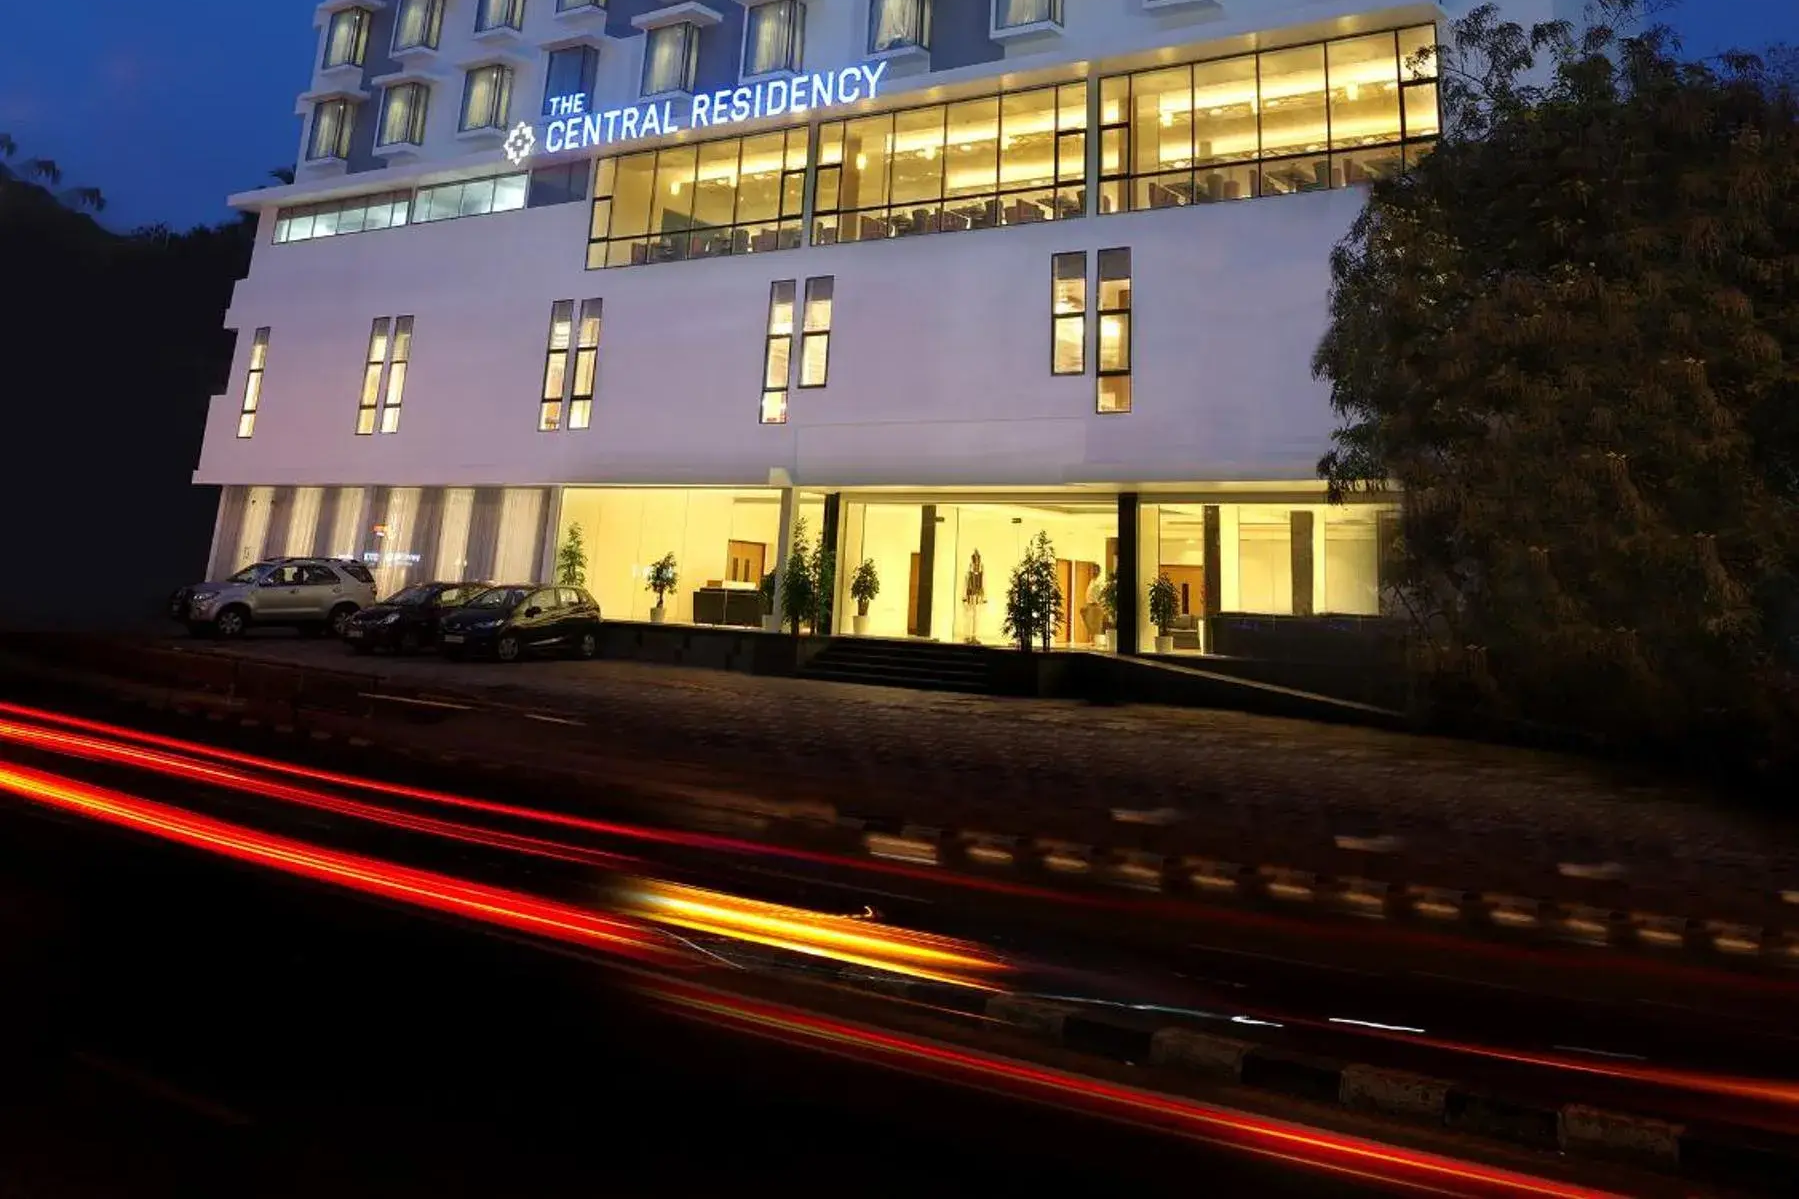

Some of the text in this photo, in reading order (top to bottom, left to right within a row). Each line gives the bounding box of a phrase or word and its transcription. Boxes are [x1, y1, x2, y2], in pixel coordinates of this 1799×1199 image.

[545, 61, 888, 153] CENTRAL RESIDENCY
[549, 92, 586, 118] THE
